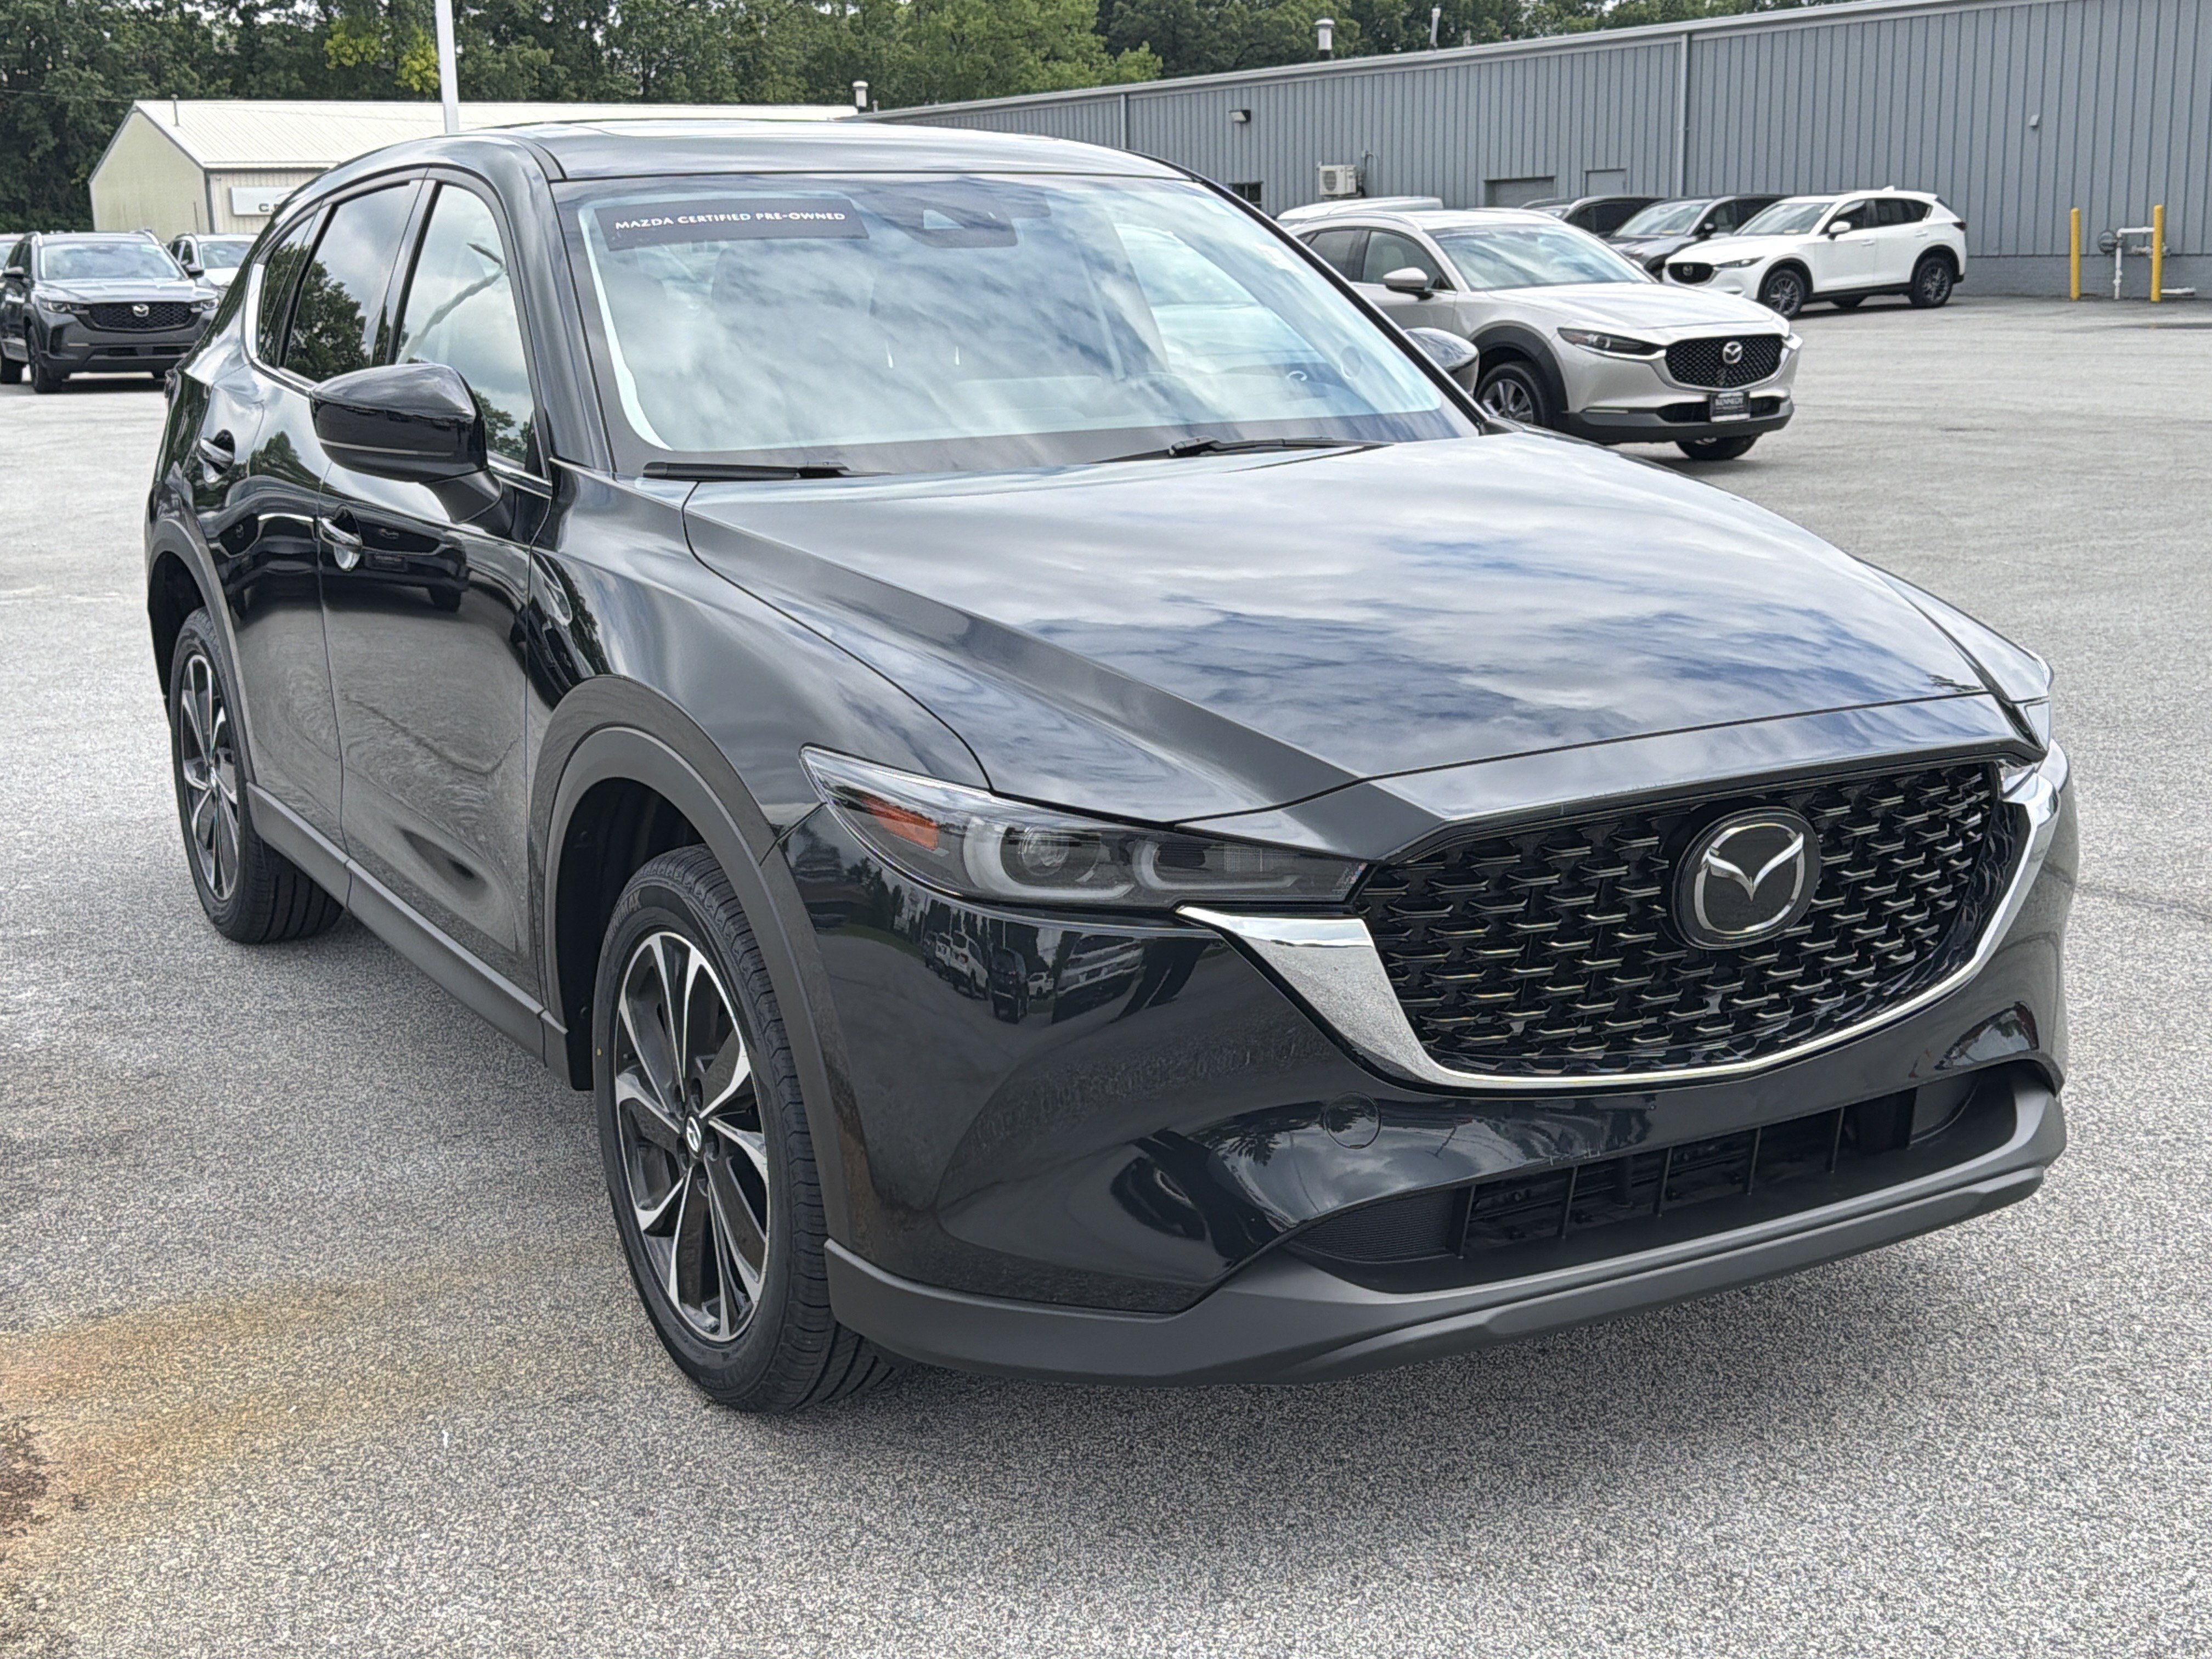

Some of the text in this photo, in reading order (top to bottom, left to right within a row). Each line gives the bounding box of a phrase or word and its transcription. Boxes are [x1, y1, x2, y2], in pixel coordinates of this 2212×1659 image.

[616, 212, 846, 230] MAZDA CERTIFIED PRE-OWNED
